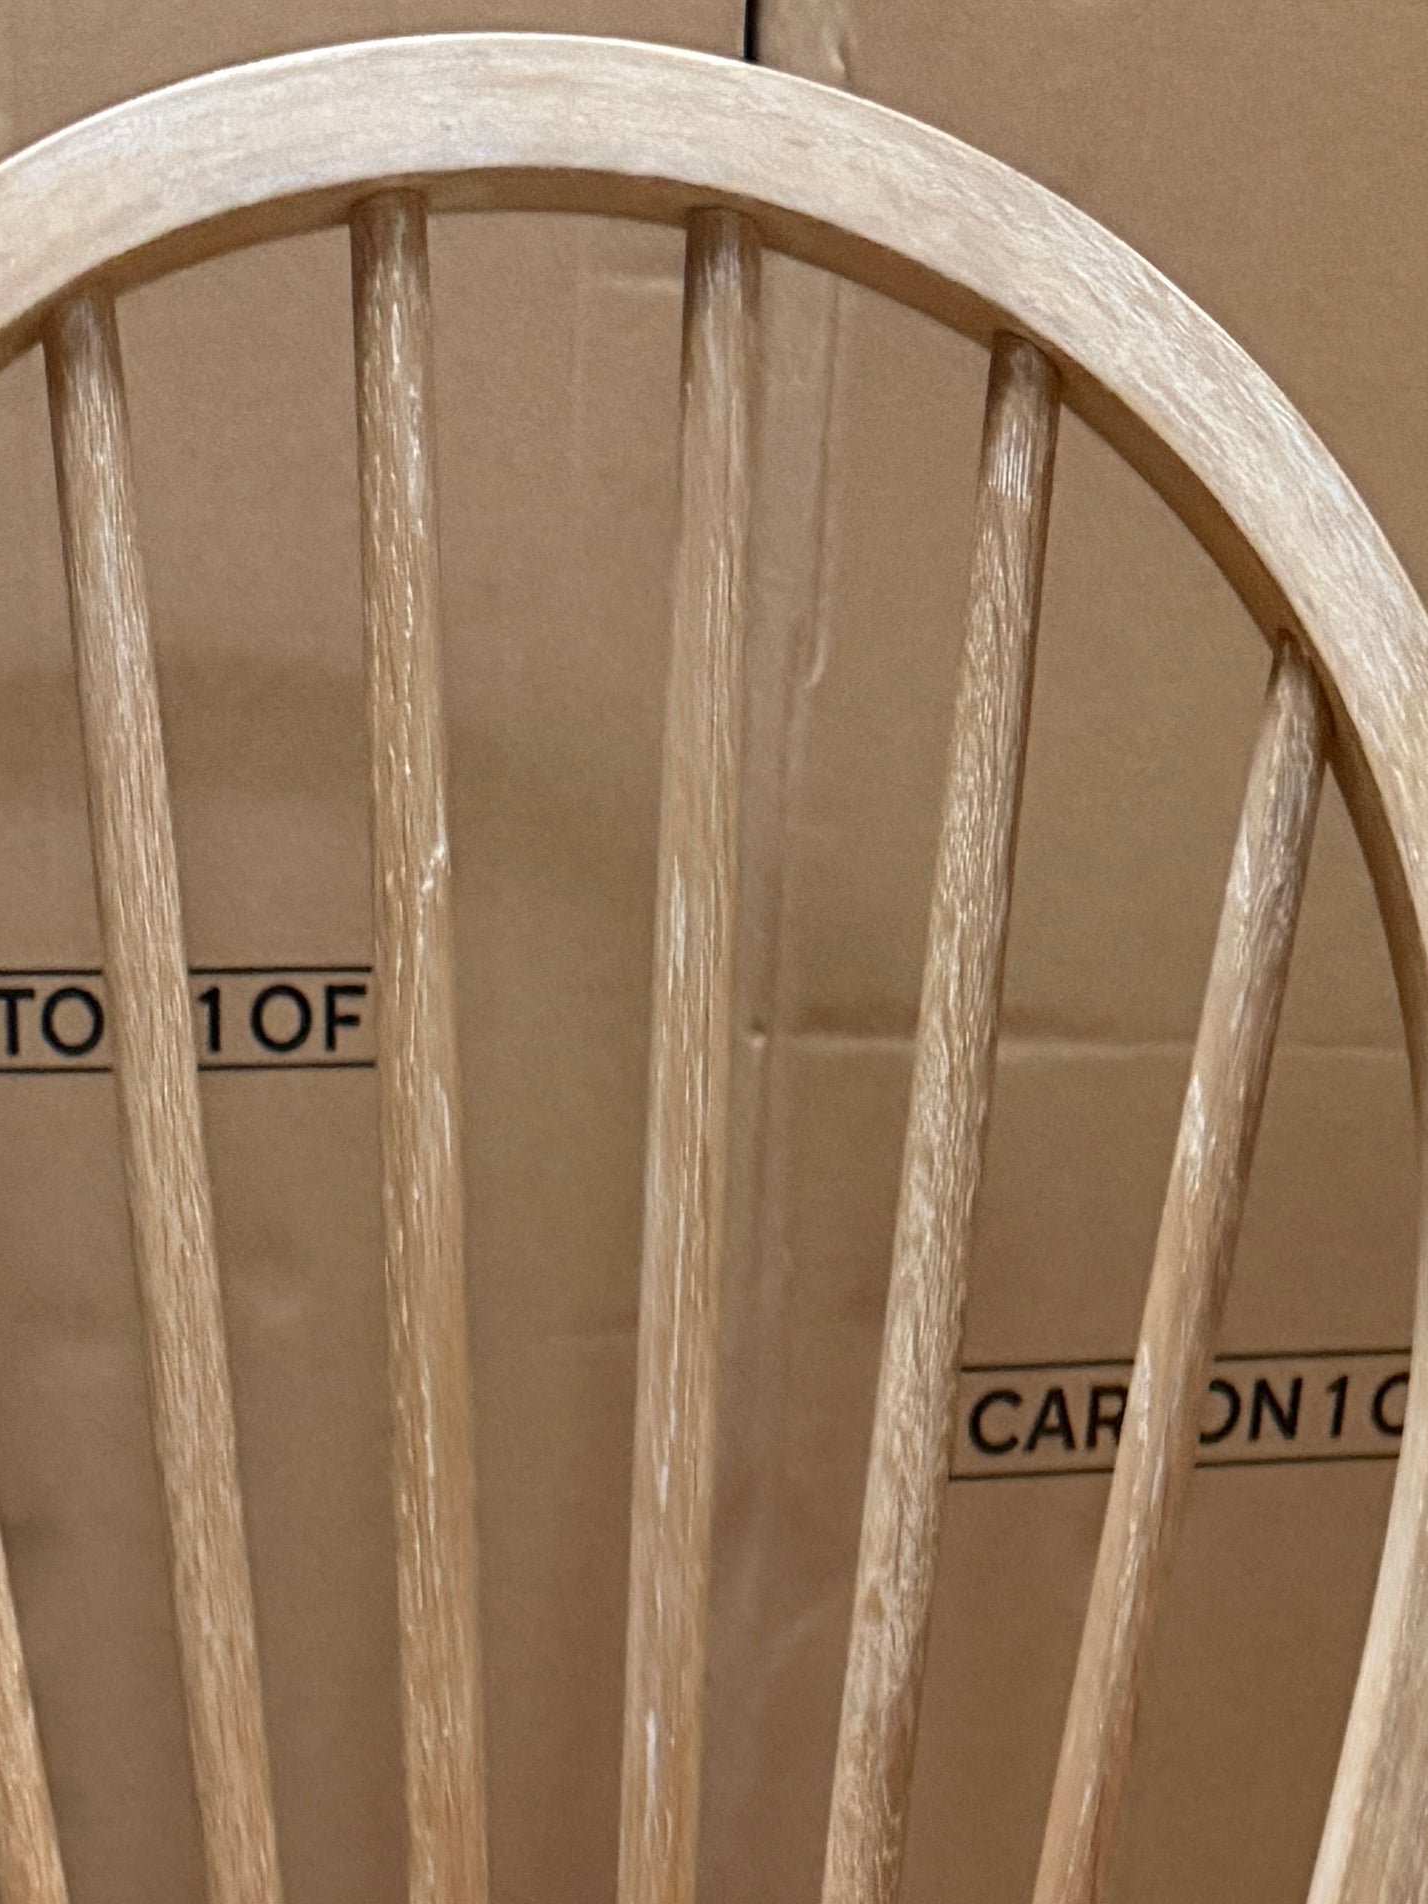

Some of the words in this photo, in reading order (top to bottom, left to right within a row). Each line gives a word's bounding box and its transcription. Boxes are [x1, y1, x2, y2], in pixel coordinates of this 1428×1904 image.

[198, 987, 221, 1054] 1
[250, 983, 367, 1053] OF
[967, 1376, 1304, 1456] CARON
[1325, 1375, 1349, 1438] 1
